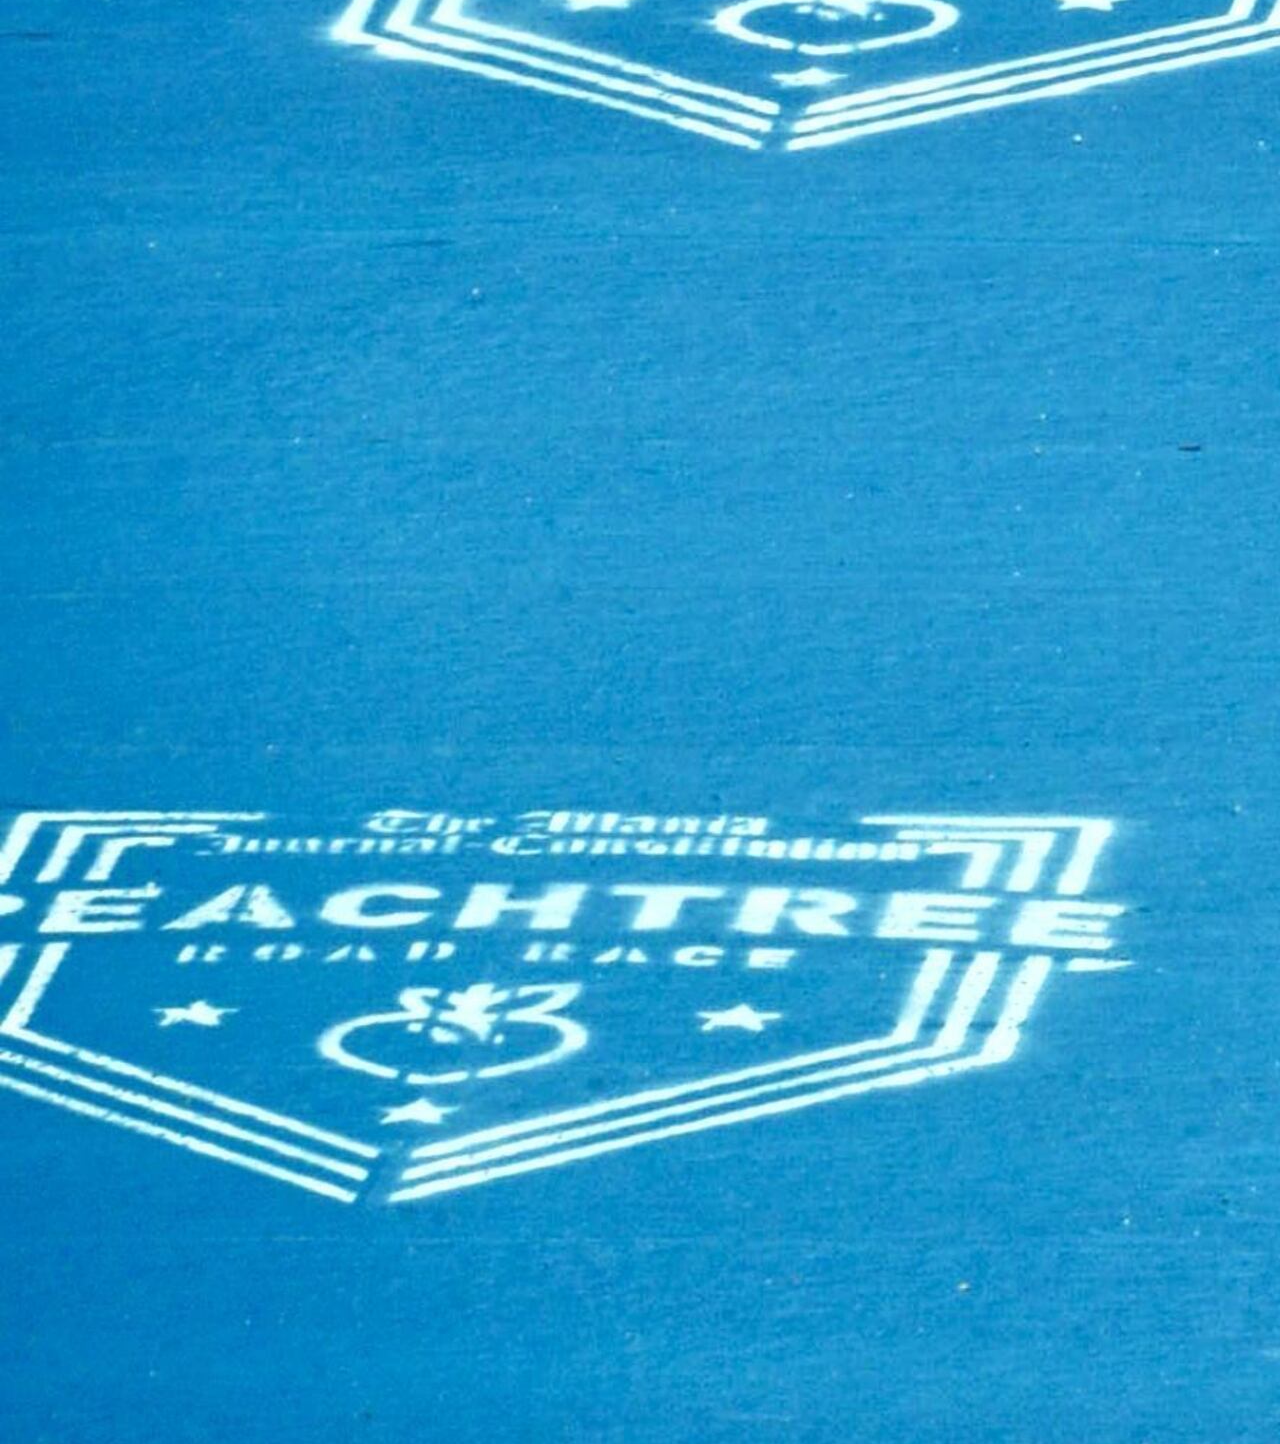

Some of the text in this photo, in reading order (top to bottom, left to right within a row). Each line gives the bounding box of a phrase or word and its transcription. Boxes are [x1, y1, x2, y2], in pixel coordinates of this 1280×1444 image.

[0, 883, 1127, 951] EACHTREE
[175, 940, 798, 970] ROAD RACE
